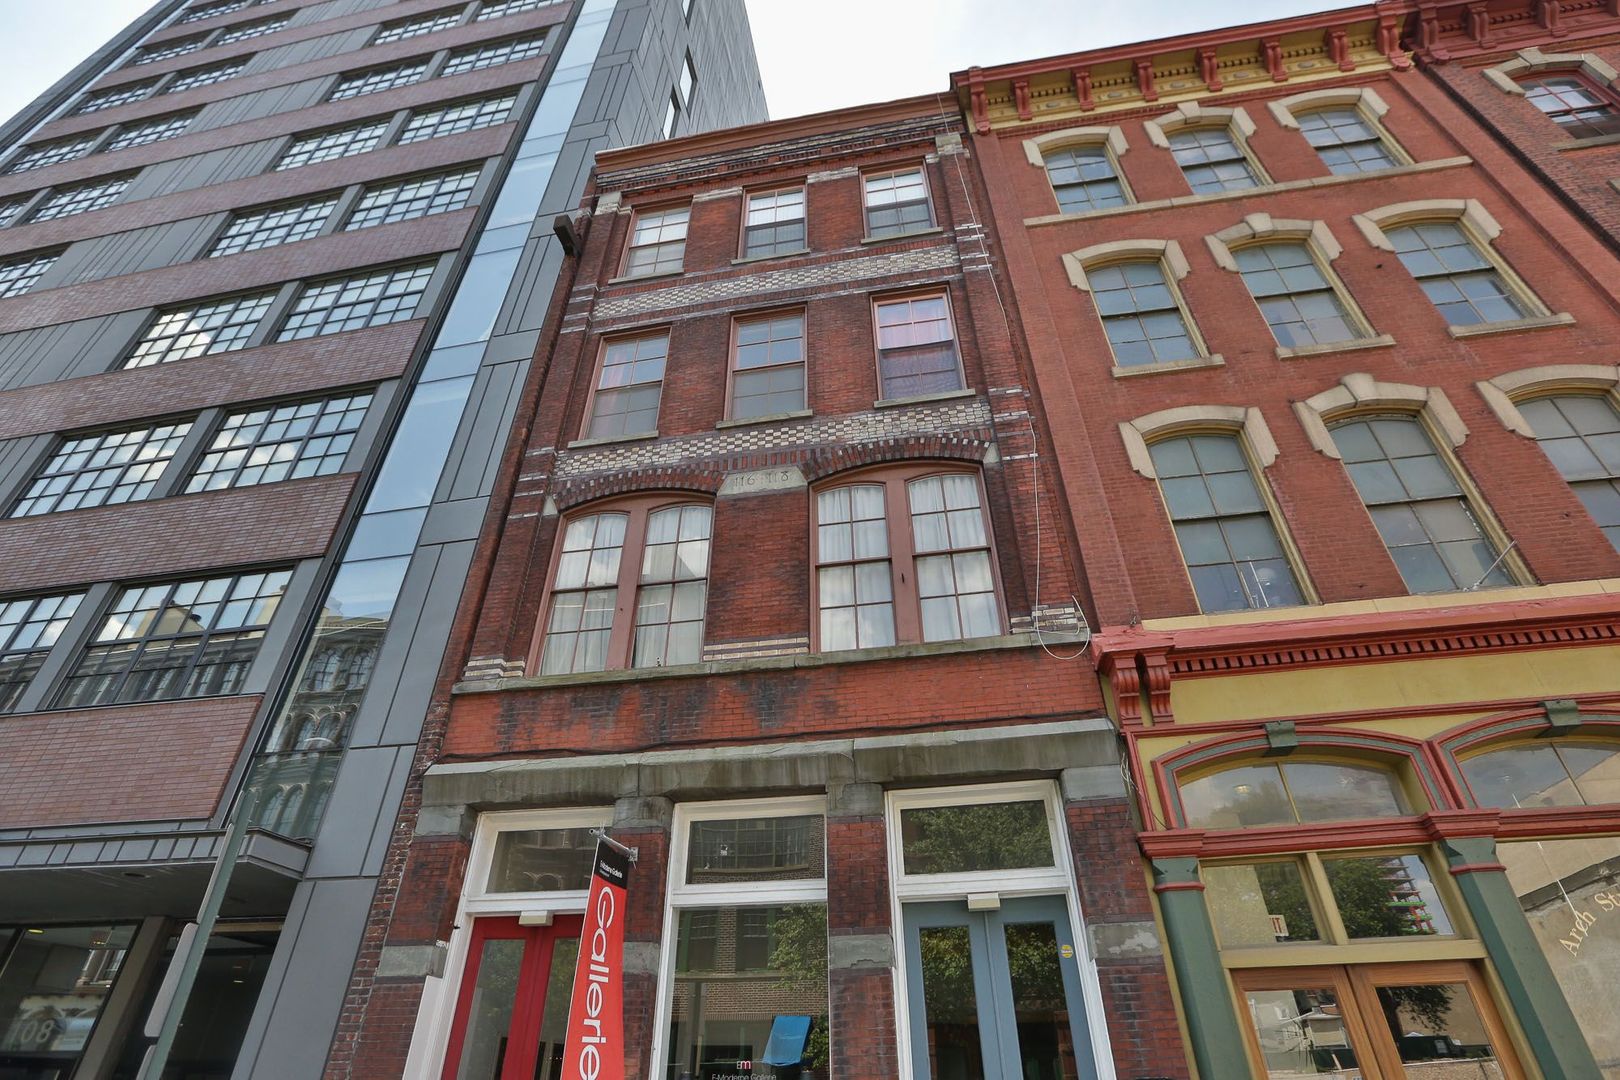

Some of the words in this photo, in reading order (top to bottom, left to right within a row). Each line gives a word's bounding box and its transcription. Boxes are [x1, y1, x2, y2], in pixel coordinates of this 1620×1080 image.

[579, 886, 615, 1080] Gallerie
[1560, 910, 1597, 957] Arch
[1594, 892, 1620, 912] St
